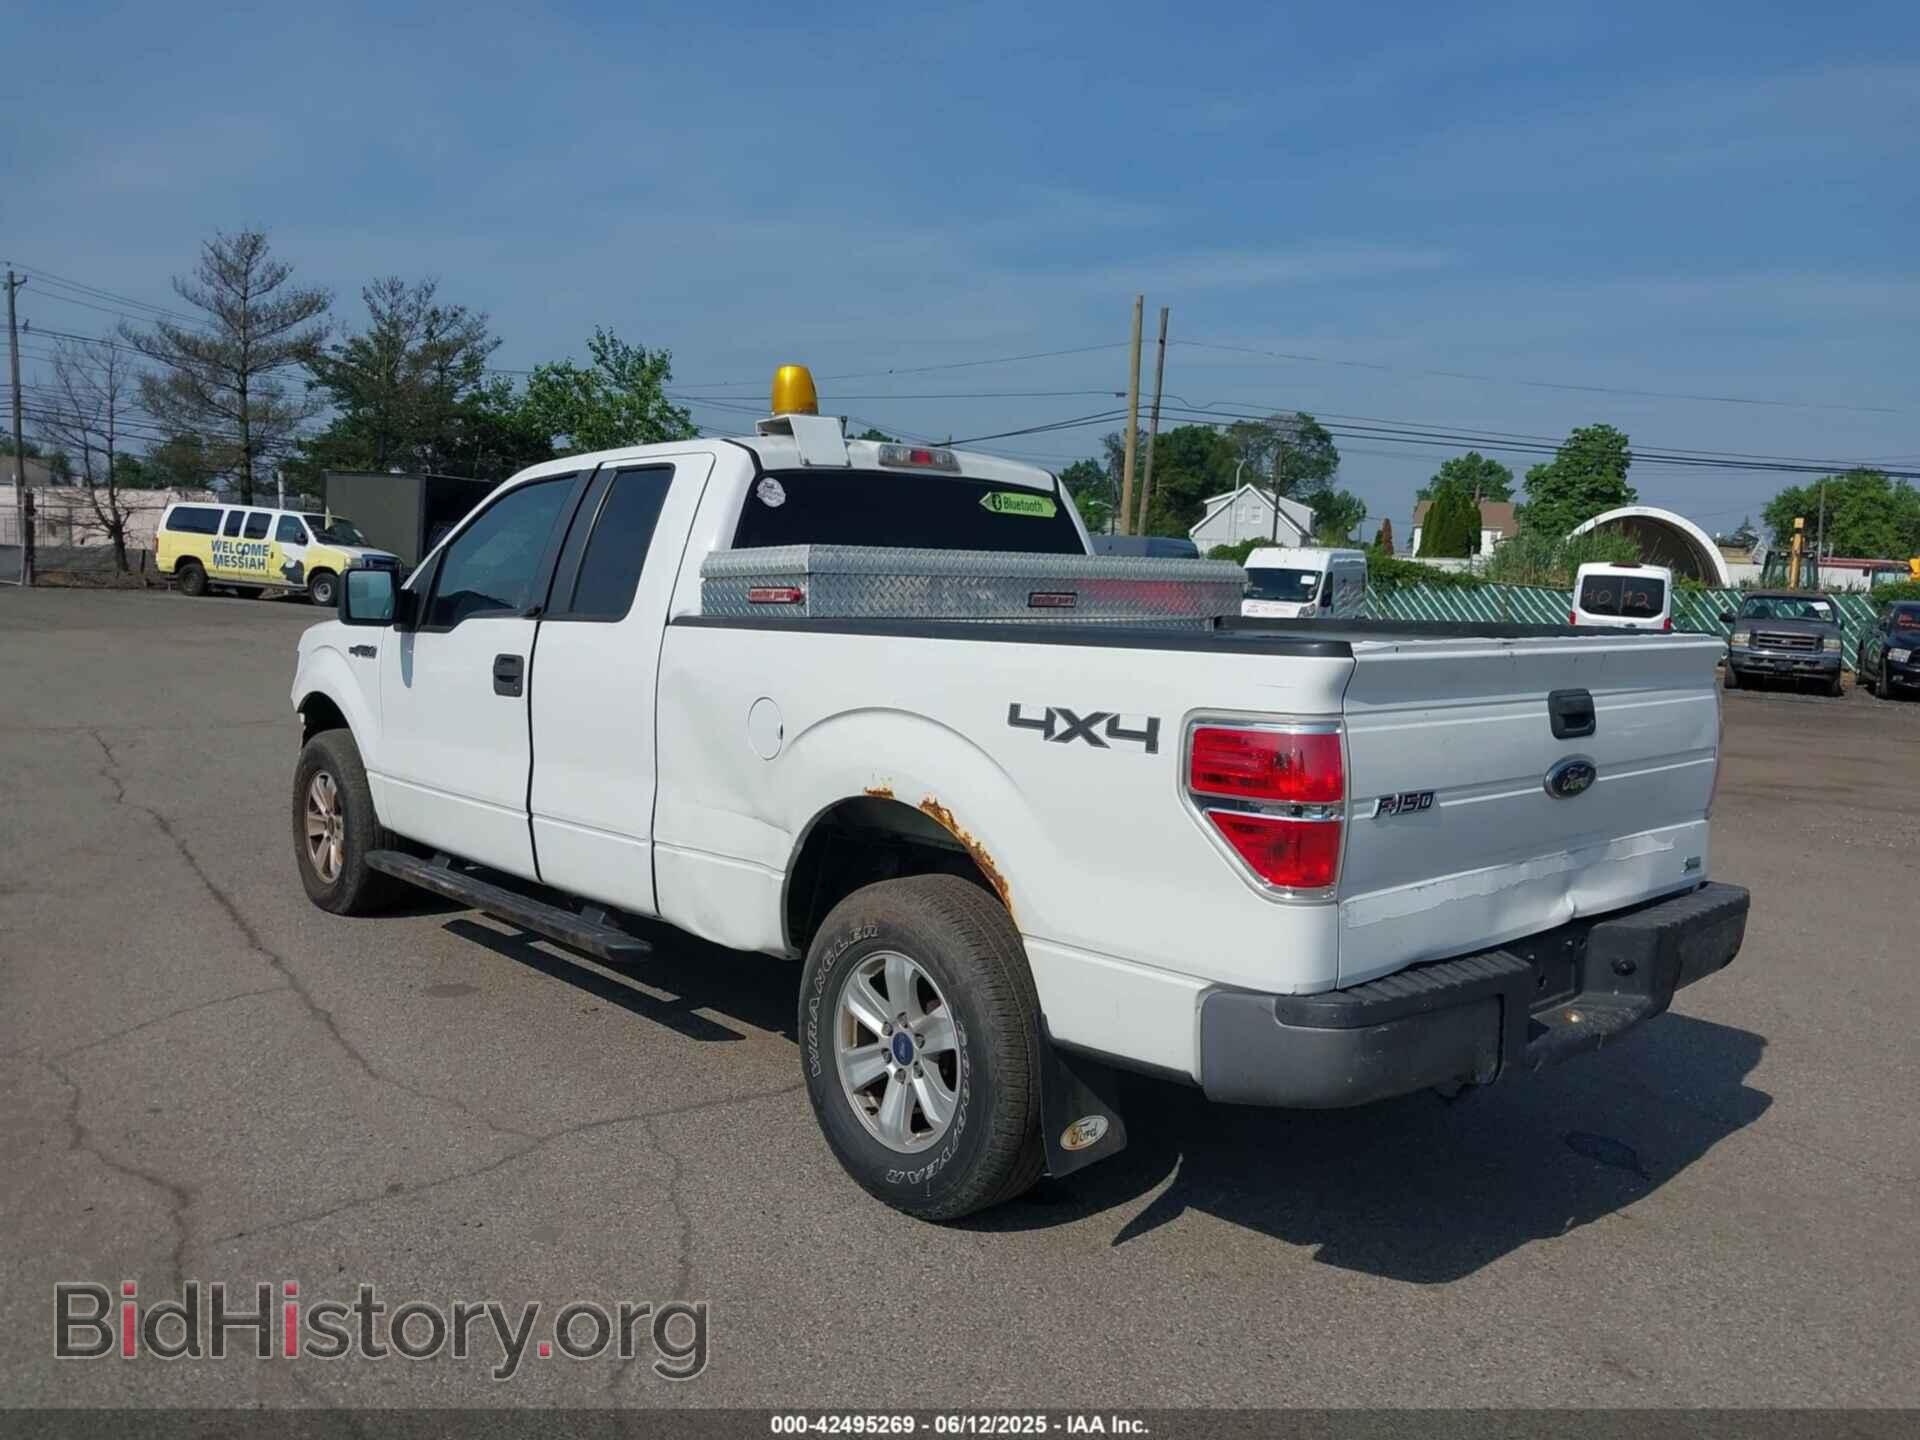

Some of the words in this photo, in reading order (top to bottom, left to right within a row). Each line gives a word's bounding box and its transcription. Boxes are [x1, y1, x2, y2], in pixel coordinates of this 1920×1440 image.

[1002, 495, 1044, 512] Bluetooth
[211, 539, 270, 557] WELCOME
[213, 553, 266, 570] MESSIAH
[807, 923, 880, 1078] WRANGLER
[886, 1020, 971, 1185] GOODYEAR
